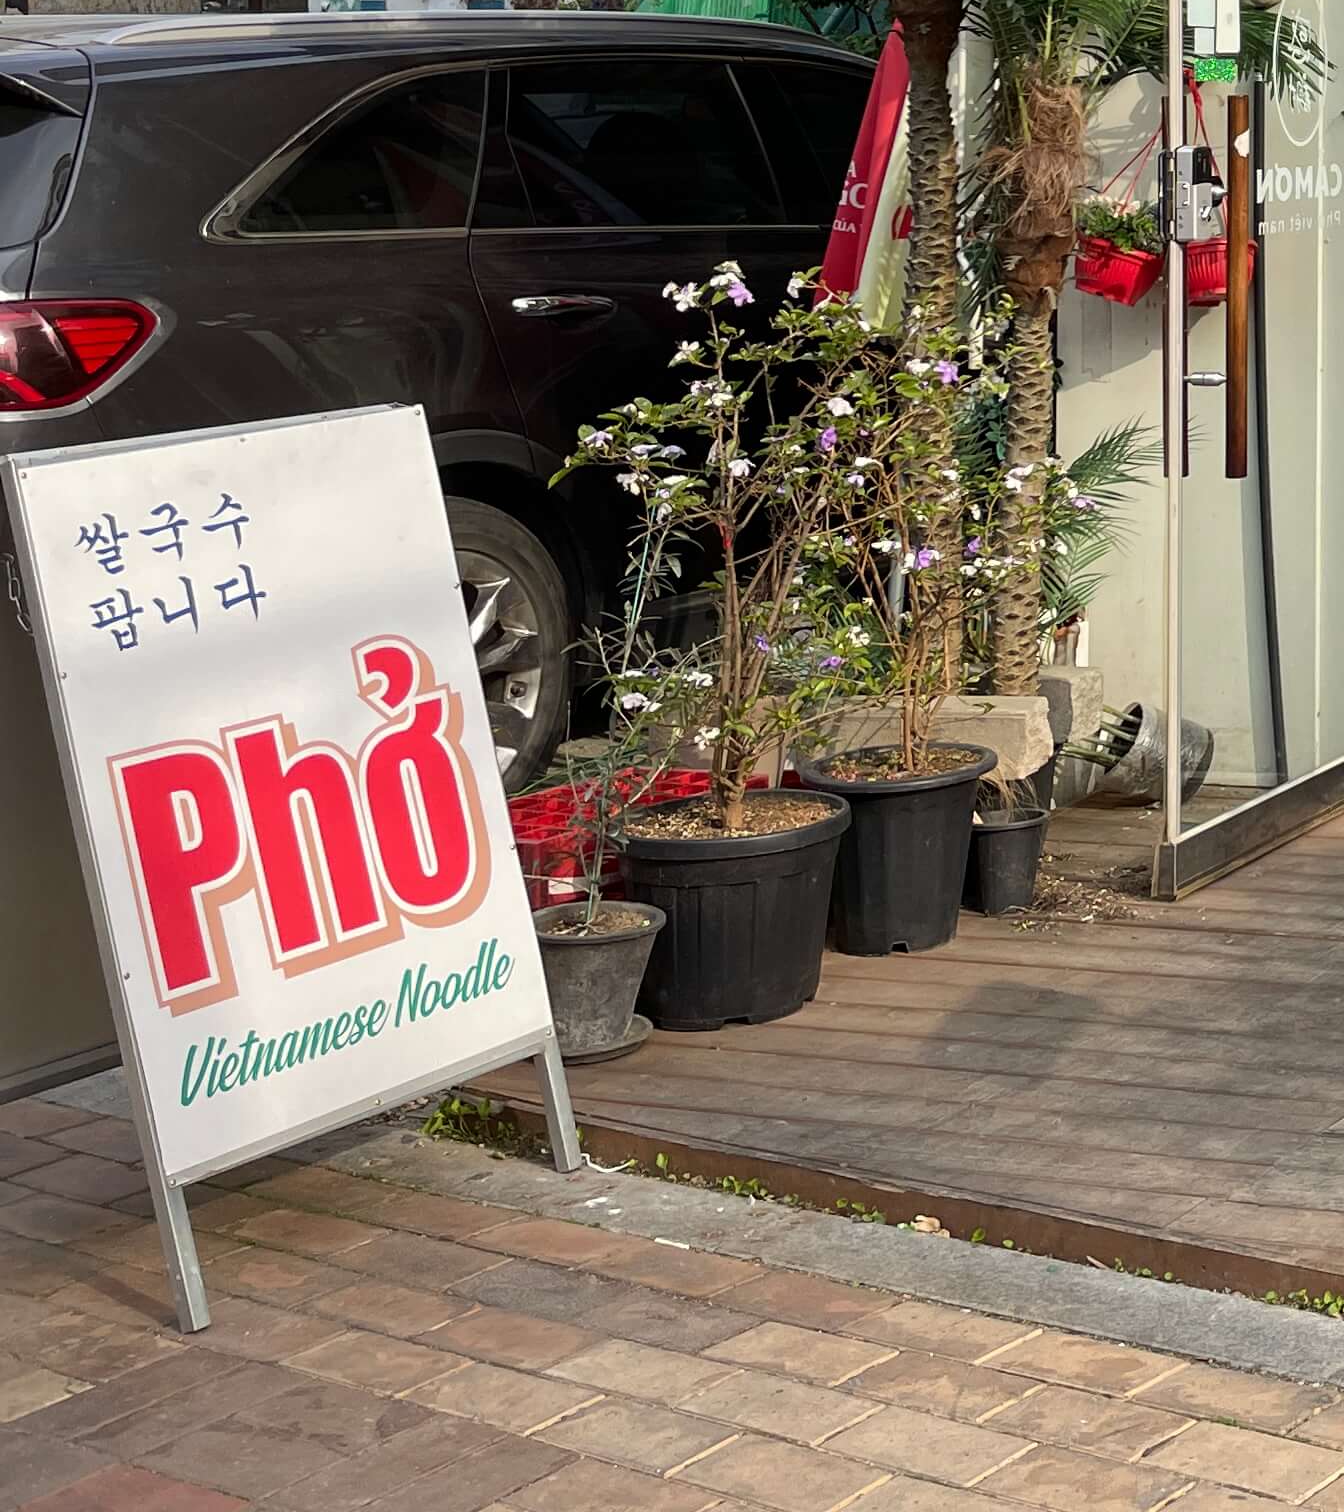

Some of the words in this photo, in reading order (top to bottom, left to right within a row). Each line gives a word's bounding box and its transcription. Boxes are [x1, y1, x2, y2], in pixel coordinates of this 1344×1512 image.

[74, 492, 252, 575] 쌀국수
[91, 564, 267, 651] 팝니다
[108, 636, 475, 1008] Phở
[180, 996, 391, 1107] Vietnamese
[393, 937, 516, 1029] Noodle
